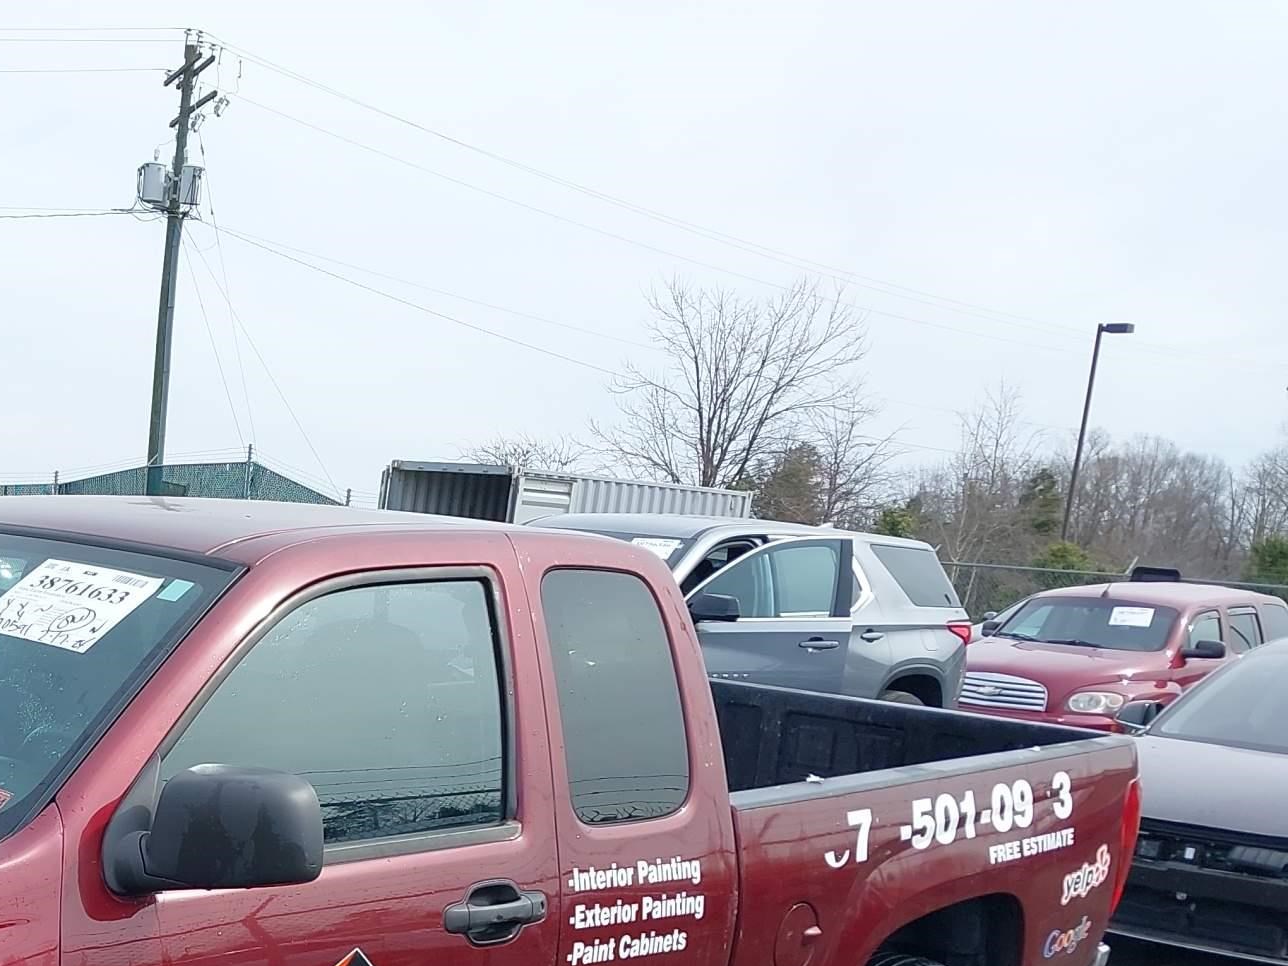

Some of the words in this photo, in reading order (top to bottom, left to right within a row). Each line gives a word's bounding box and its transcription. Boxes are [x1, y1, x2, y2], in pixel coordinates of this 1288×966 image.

[29, 574, 131, 605] 38761633
[989, 842, 1022, 865] FREE
[1022, 828, 1075, 859] ESTIMATE
[568, 862, 634, 892] -Interior
[637, 856, 701, 885] Painting
[1060, 862, 1096, 906] yelp
[569, 899, 639, 929] -Exterior
[642, 892, 705, 919] Painting
[567, 938, 616, 966] -Paint
[619, 929, 688, 959] Cabinets
[1043, 915, 1092, 958] Google
